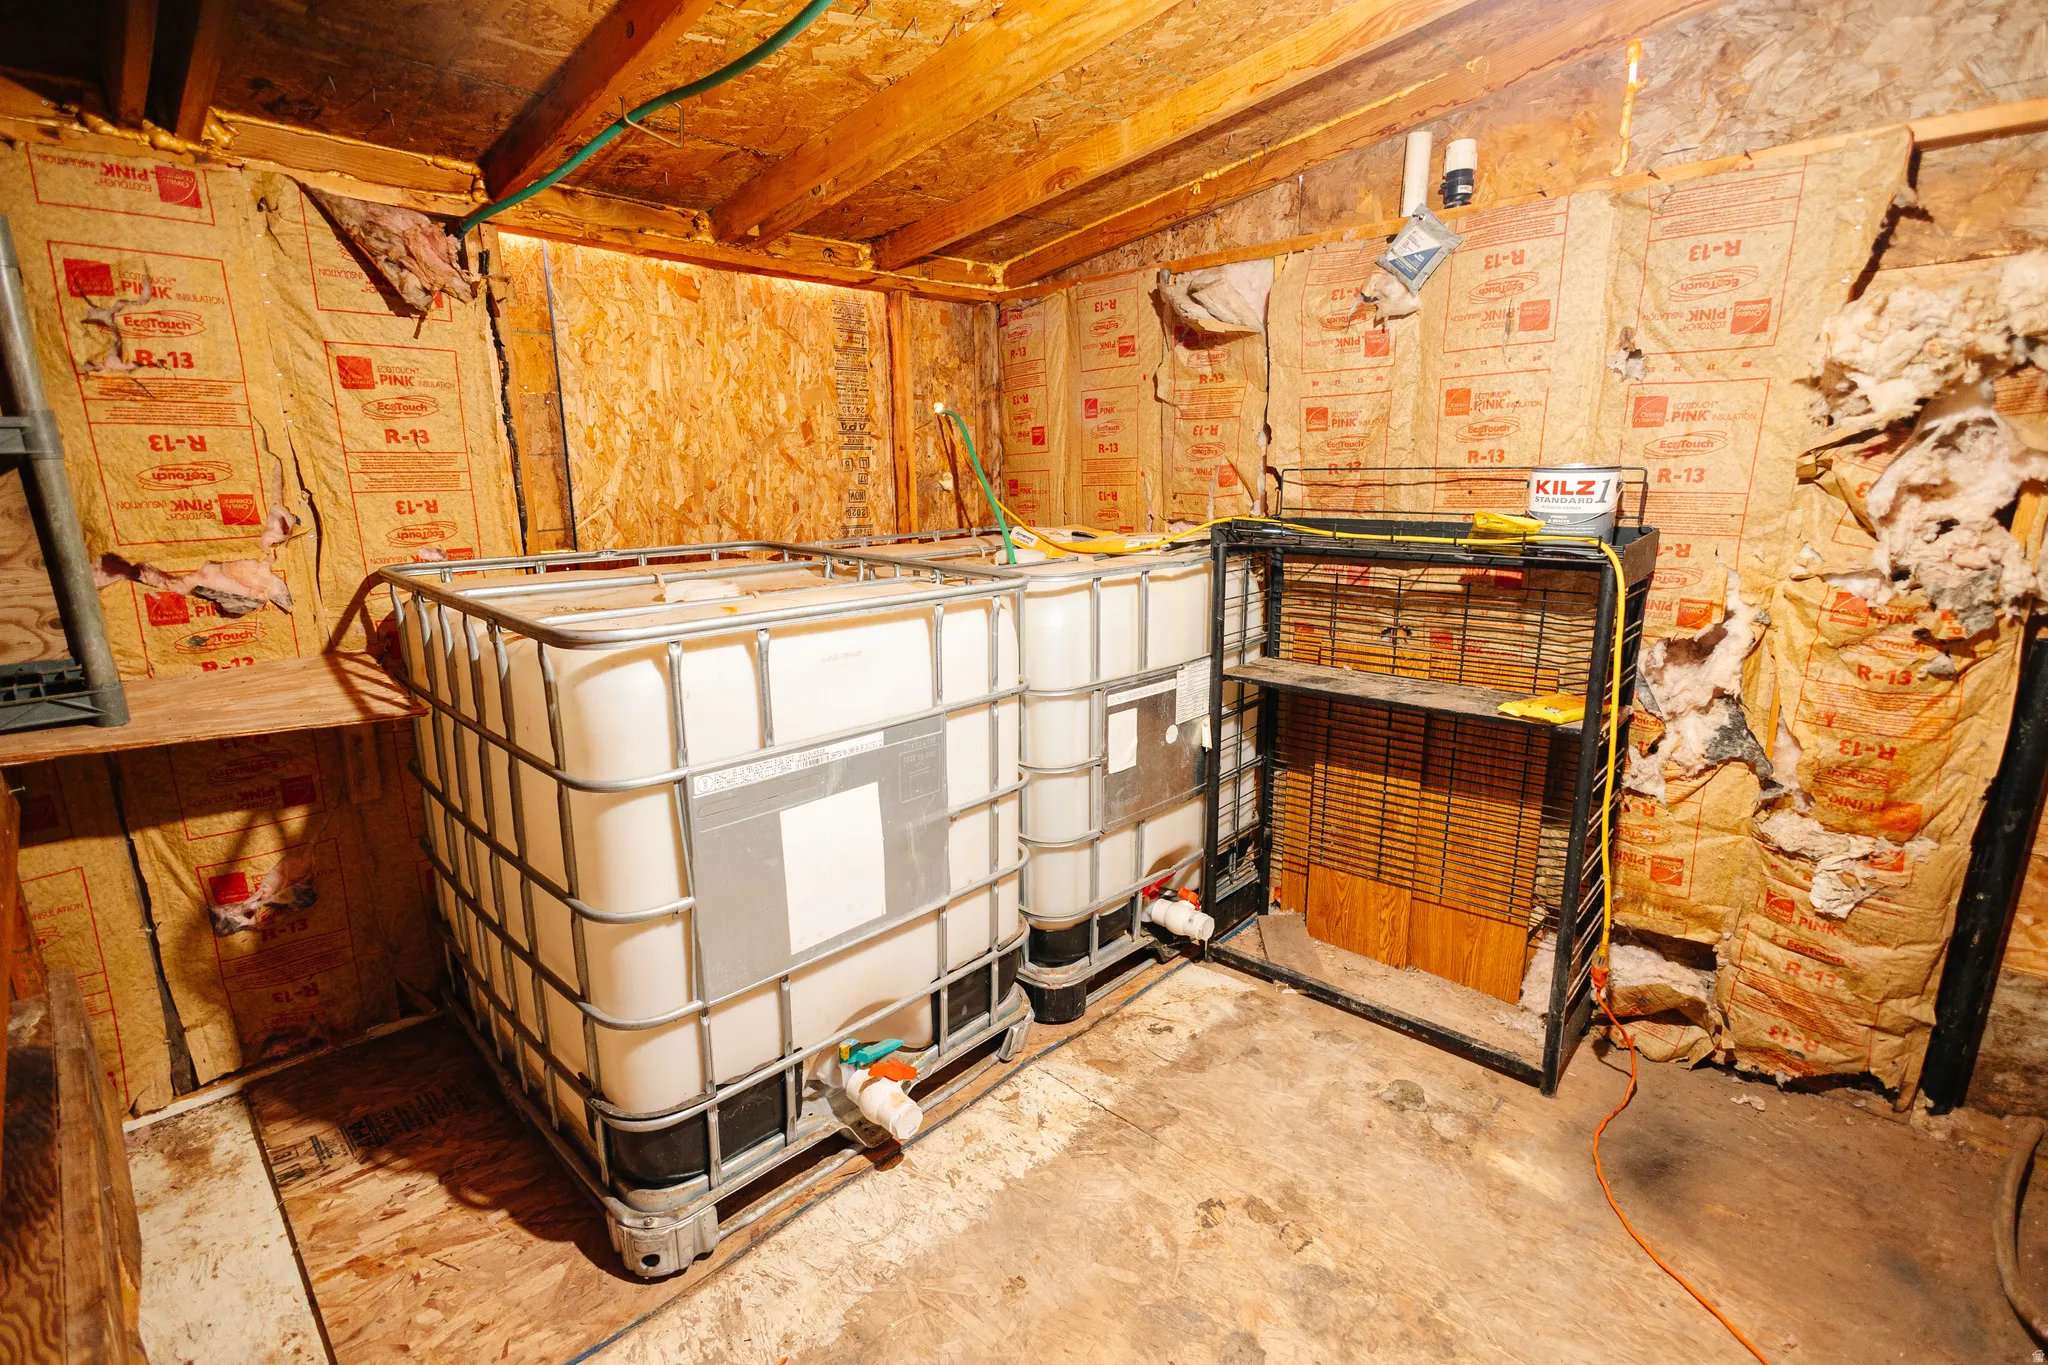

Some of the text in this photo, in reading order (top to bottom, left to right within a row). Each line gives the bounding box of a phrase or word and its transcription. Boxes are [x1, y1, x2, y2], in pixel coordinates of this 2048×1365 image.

[100, 162, 150, 182] PINK
[1688, 239, 1742, 262] R-13
[1483, 249, 1525, 270] R-13
[318, 268, 363, 280] INSULATION
[1680, 278, 1740, 292] EcoTouch
[176, 293, 225, 305] INSULATION
[1094, 298, 1117, 313] R-13
[1688, 307, 1727, 322] PINK
[123, 316, 192, 330] EcoTouch
[1099, 341, 1116, 350] PINK
[1335, 335, 1361, 348] PINK
[1010, 346, 1027, 359] R-13
[379, 374, 415, 387] PINK
[417, 380, 456, 389] INSULATION
[377, 402, 428, 412] EcoTouch
[1099, 407, 1115, 415] PINK
[1473, 399, 1504, 411] PINK
[1331, 418, 1358, 428] PINK
[1671, 410, 1757, 423] PINK INSULATION
[1192, 424, 1219, 437] R-13
[1467, 424, 1511, 434] EcoTouch
[148, 434, 208, 452] R-13
[384, 428, 430, 445] R-13
[1098, 442, 1119, 453] R-13
[1326, 440, 1364, 449] EcoTouch
[1658, 440, 1714, 449] EcoTouch
[1467, 448, 1505, 464] R-13
[151, 471, 216, 483] EcoTouch
[1194, 465, 1213, 476] PINK
[1656, 467, 1705, 483] R-13
[1536, 480, 1596, 496] KILZ
[1098, 490, 1118, 501] R-13
[1534, 496, 1594, 504] STANDARD
[116, 499, 214, 512] PINK INSULATION
[395, 499, 439, 515] R-13
[1857, 663, 1913, 686] R-13
[1839, 739, 1897, 761] R-13
[1797, 916, 1839, 937] PINK
[1784, 960, 1838, 990] R-13
[1768, 1025, 1820, 1055] R-13
